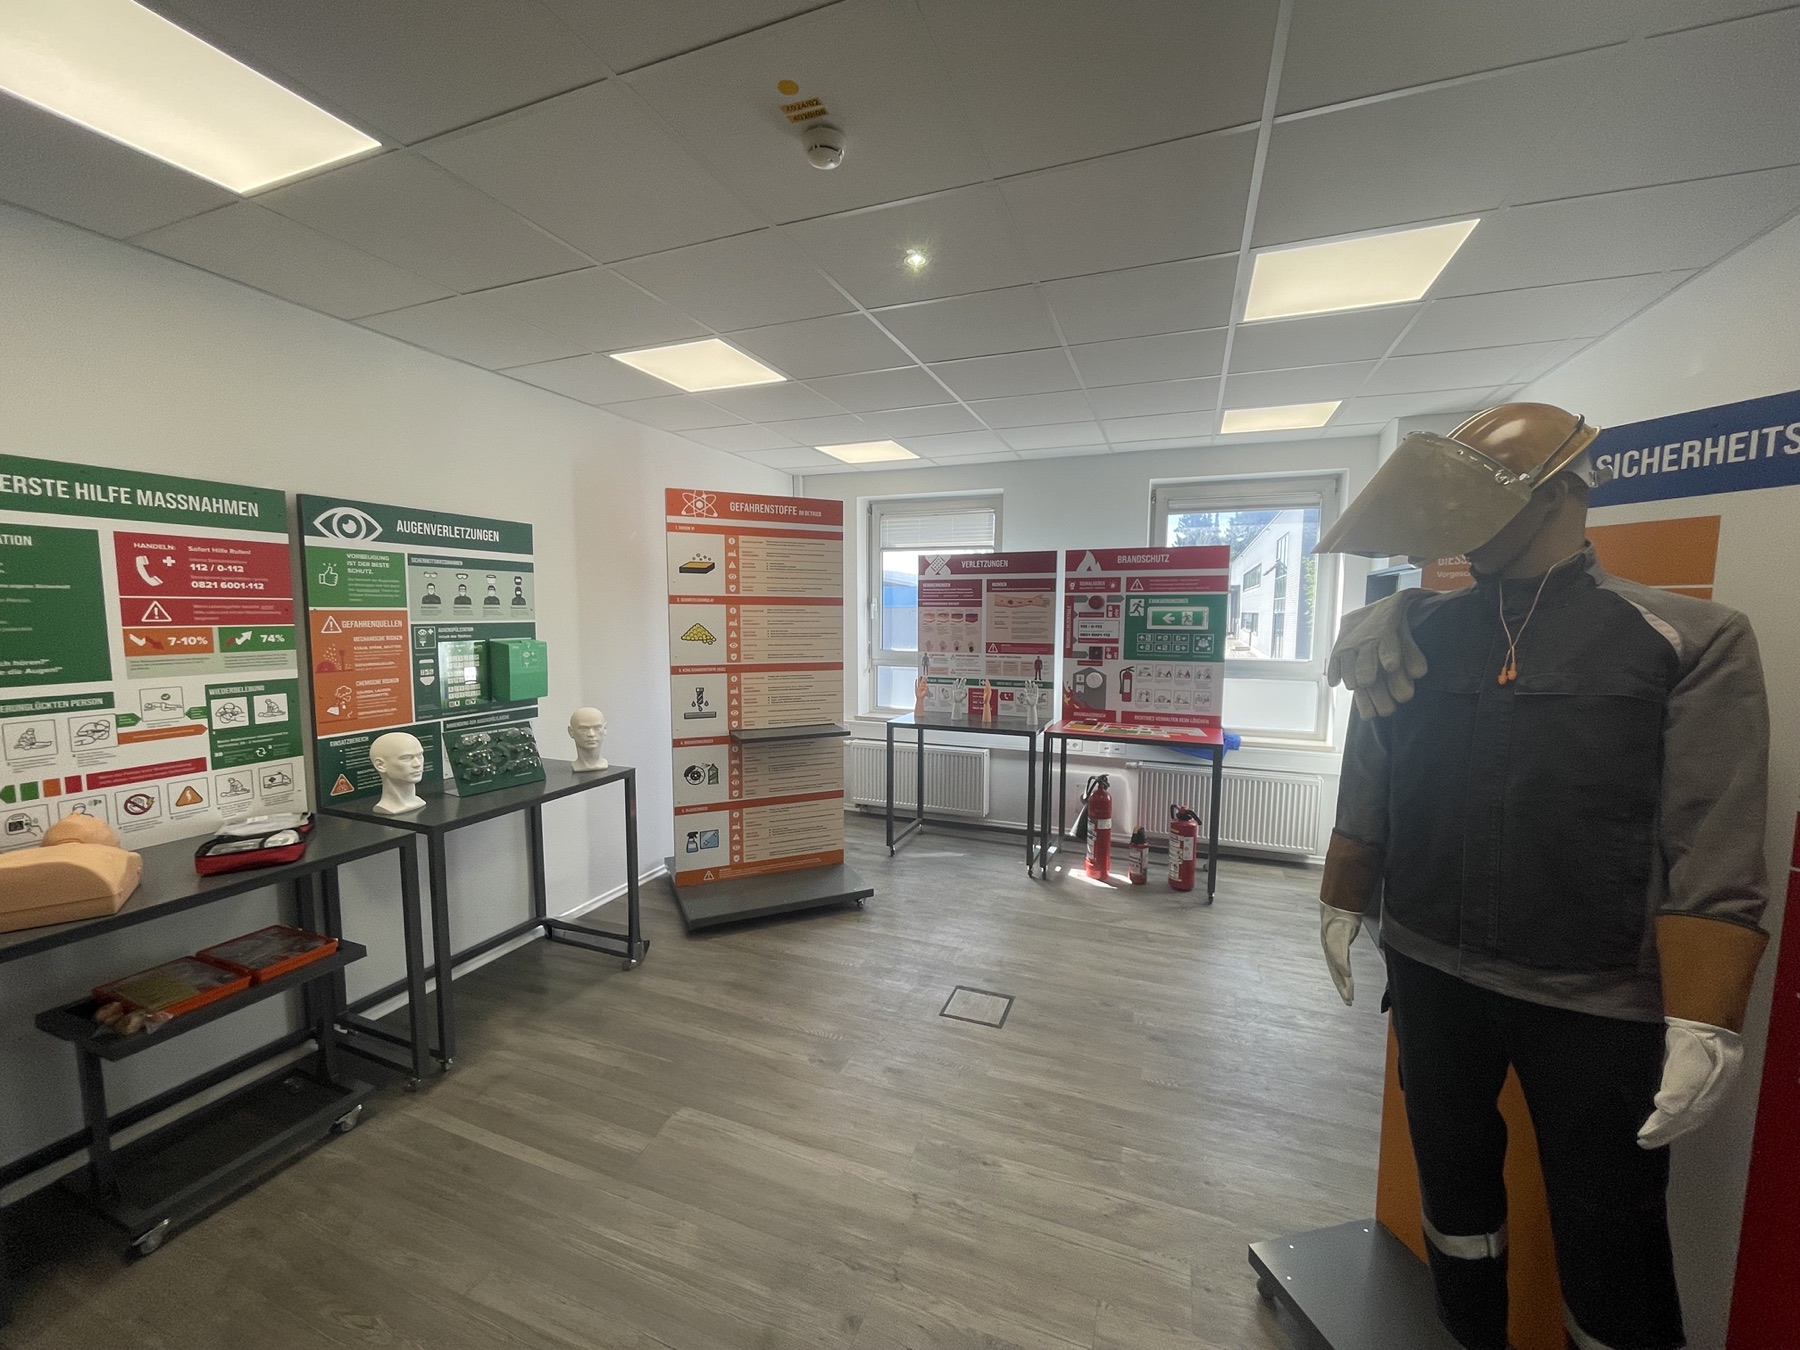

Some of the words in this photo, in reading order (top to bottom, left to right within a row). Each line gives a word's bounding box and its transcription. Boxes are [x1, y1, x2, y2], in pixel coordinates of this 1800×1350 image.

[0, 473, 70, 499] ERSTE
[74, 481, 133, 505] HILFE
[136, 489, 259, 518] MASSNAHMEN
[729, 501, 797, 515] GEFAHRENSTOFFE
[396, 519, 500, 542] AUGENVERLETZUNGEN
[133, 542, 176, 551] HANDELN:
[961, 559, 1009, 568] VERLETZUNGEN
[1117, 554, 1170, 564] BRANDSCHUTZ
[190, 563, 208, 571] 112
[217, 564, 244, 573] 0-112
[191, 581, 218, 589] 0821
[220, 582, 264, 590] 6001-112
[341, 620, 403, 629] GEFAHRENQUELLEN
[167, 636, 208, 646] 7-10%
[260, 634, 285, 643] 74%
